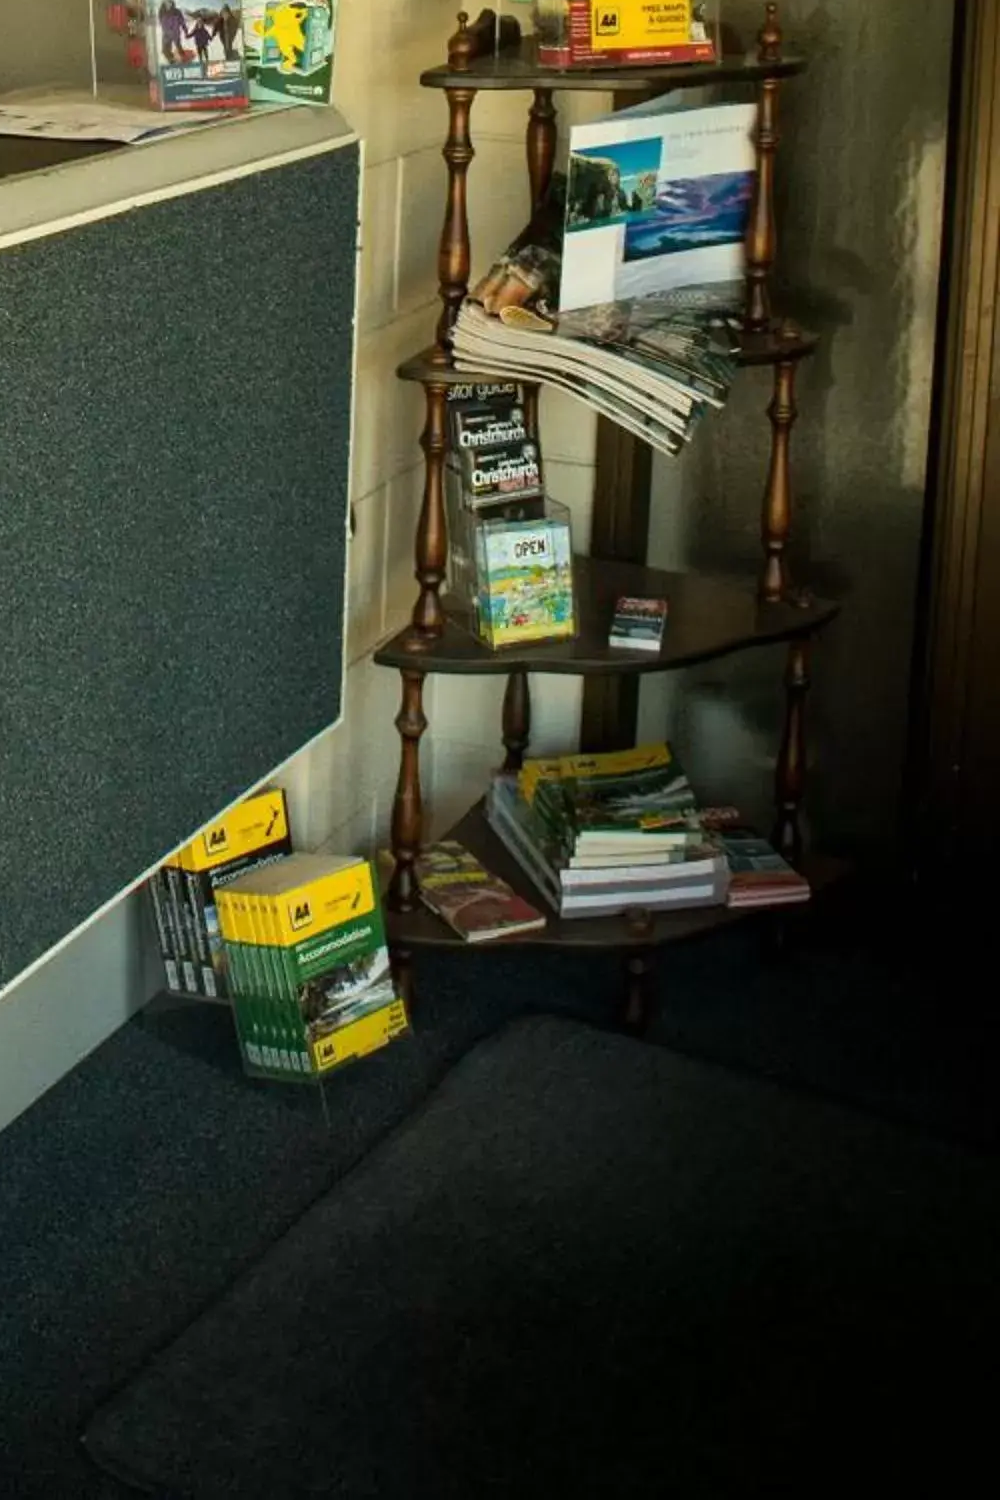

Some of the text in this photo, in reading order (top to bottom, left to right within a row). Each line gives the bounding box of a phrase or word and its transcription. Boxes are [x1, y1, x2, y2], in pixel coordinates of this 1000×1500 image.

[600, 13, 617, 27] AA
[460, 427, 526, 447] Christchurch
[471, 461, 539, 486] Christchurch
[514, 539, 546, 558] OPEN
[209, 827, 226, 847] AA
[295, 902, 310, 921] AA
[298, 925, 372, 964] Accommodation
